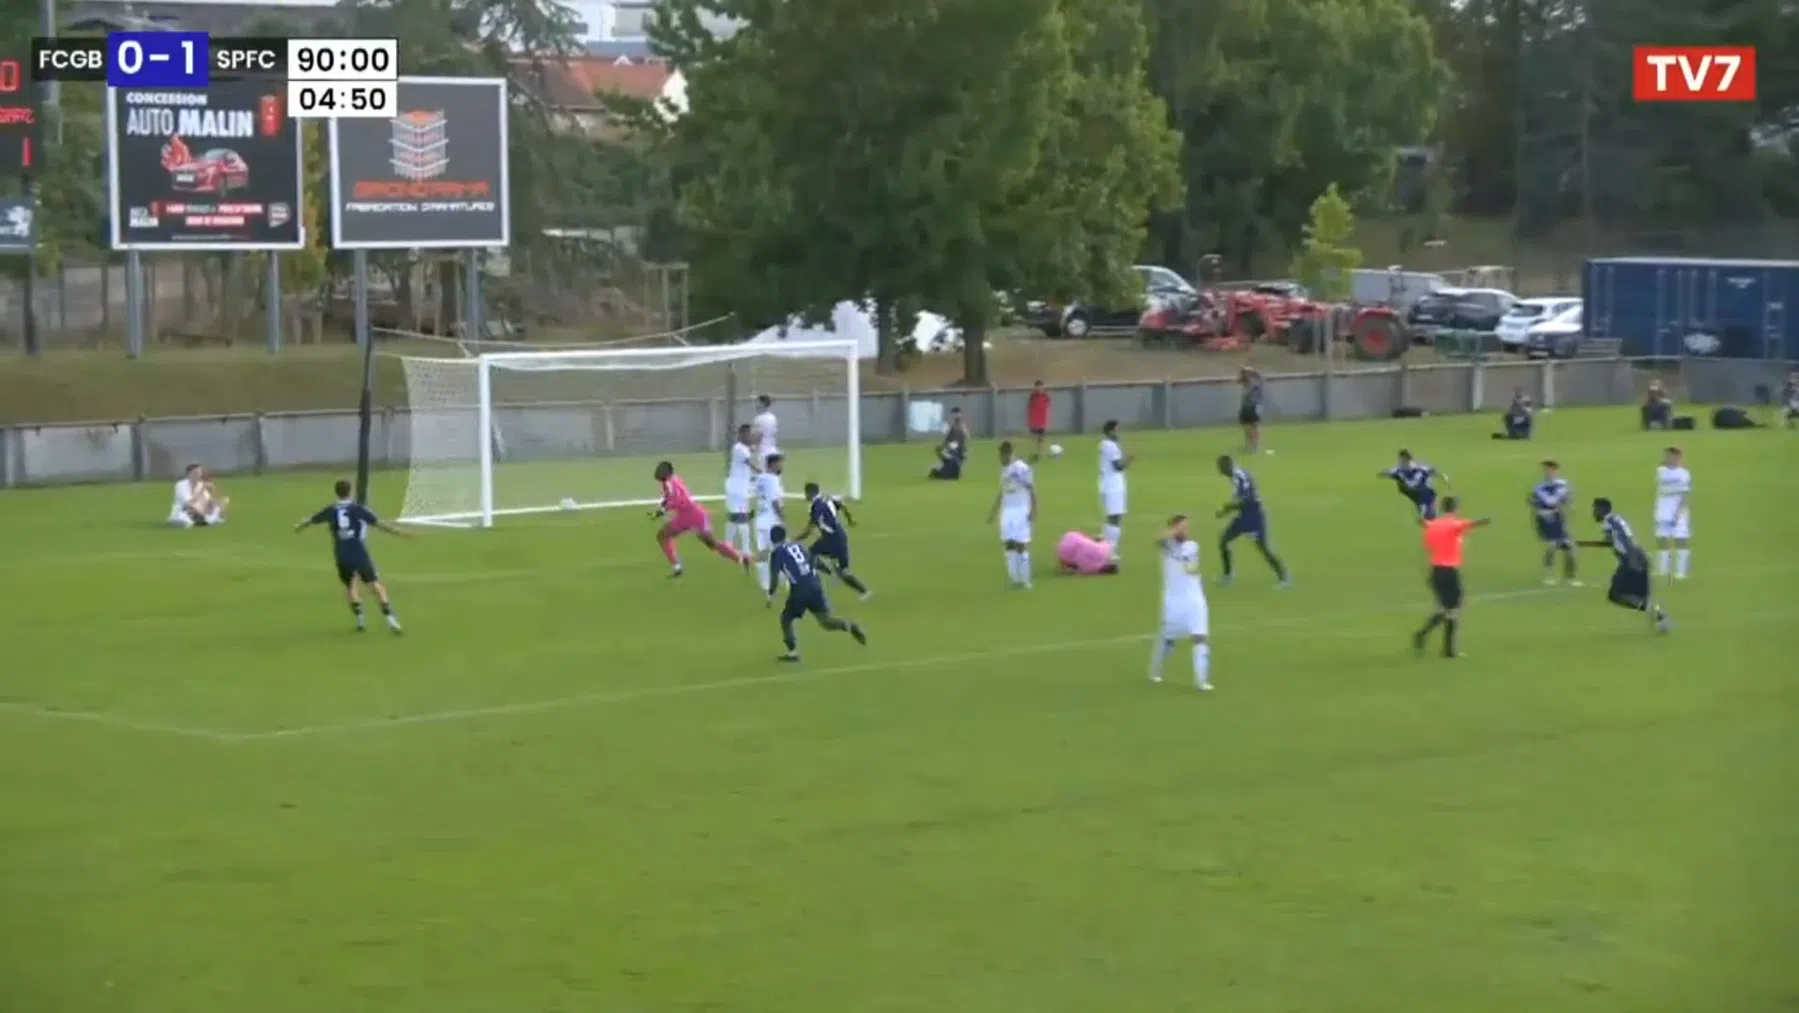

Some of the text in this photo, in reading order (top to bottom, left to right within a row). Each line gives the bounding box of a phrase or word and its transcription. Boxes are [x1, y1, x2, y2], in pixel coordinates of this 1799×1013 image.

[126, 92, 207, 105] CONCESSION
[126, 108, 254, 137] AUTO MALIN
